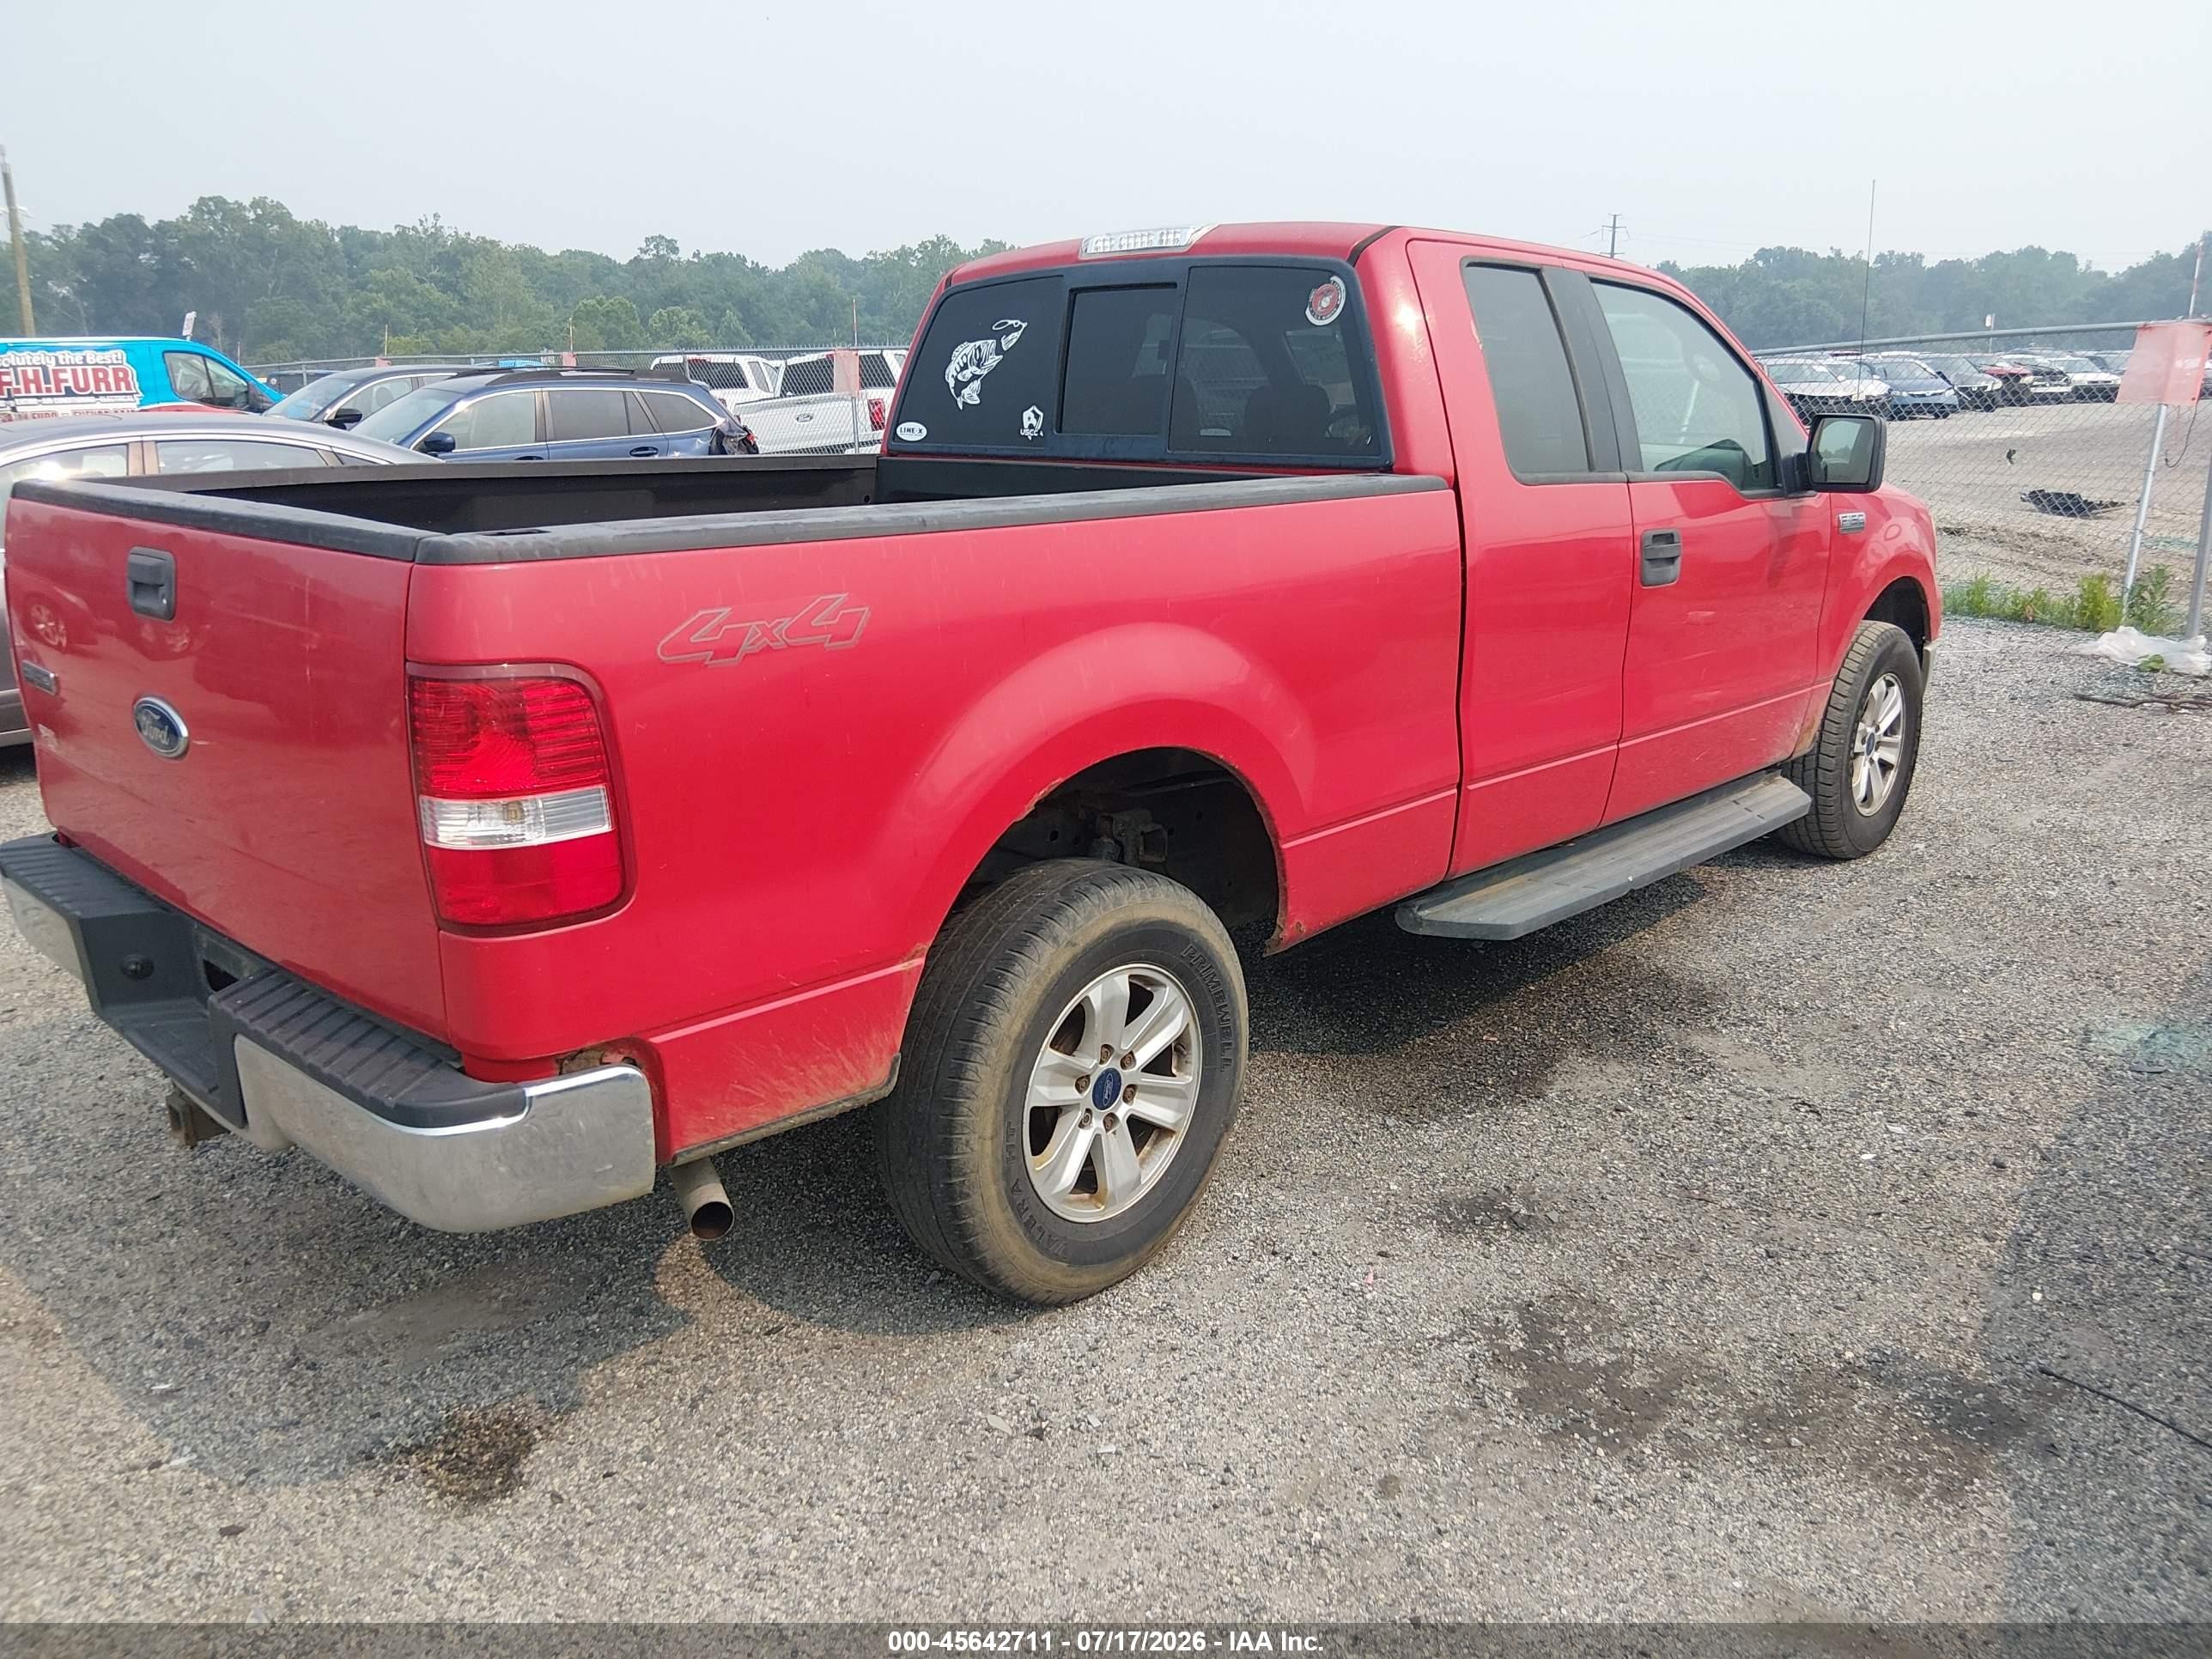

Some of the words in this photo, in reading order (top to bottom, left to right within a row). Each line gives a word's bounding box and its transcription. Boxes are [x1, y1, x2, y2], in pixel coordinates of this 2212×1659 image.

[59, 352, 83, 365] the
[86, 352, 123, 364] Best!
[657, 592, 872, 668] 4x4
[1180, 944, 1234, 1072] PRIMEWELL
